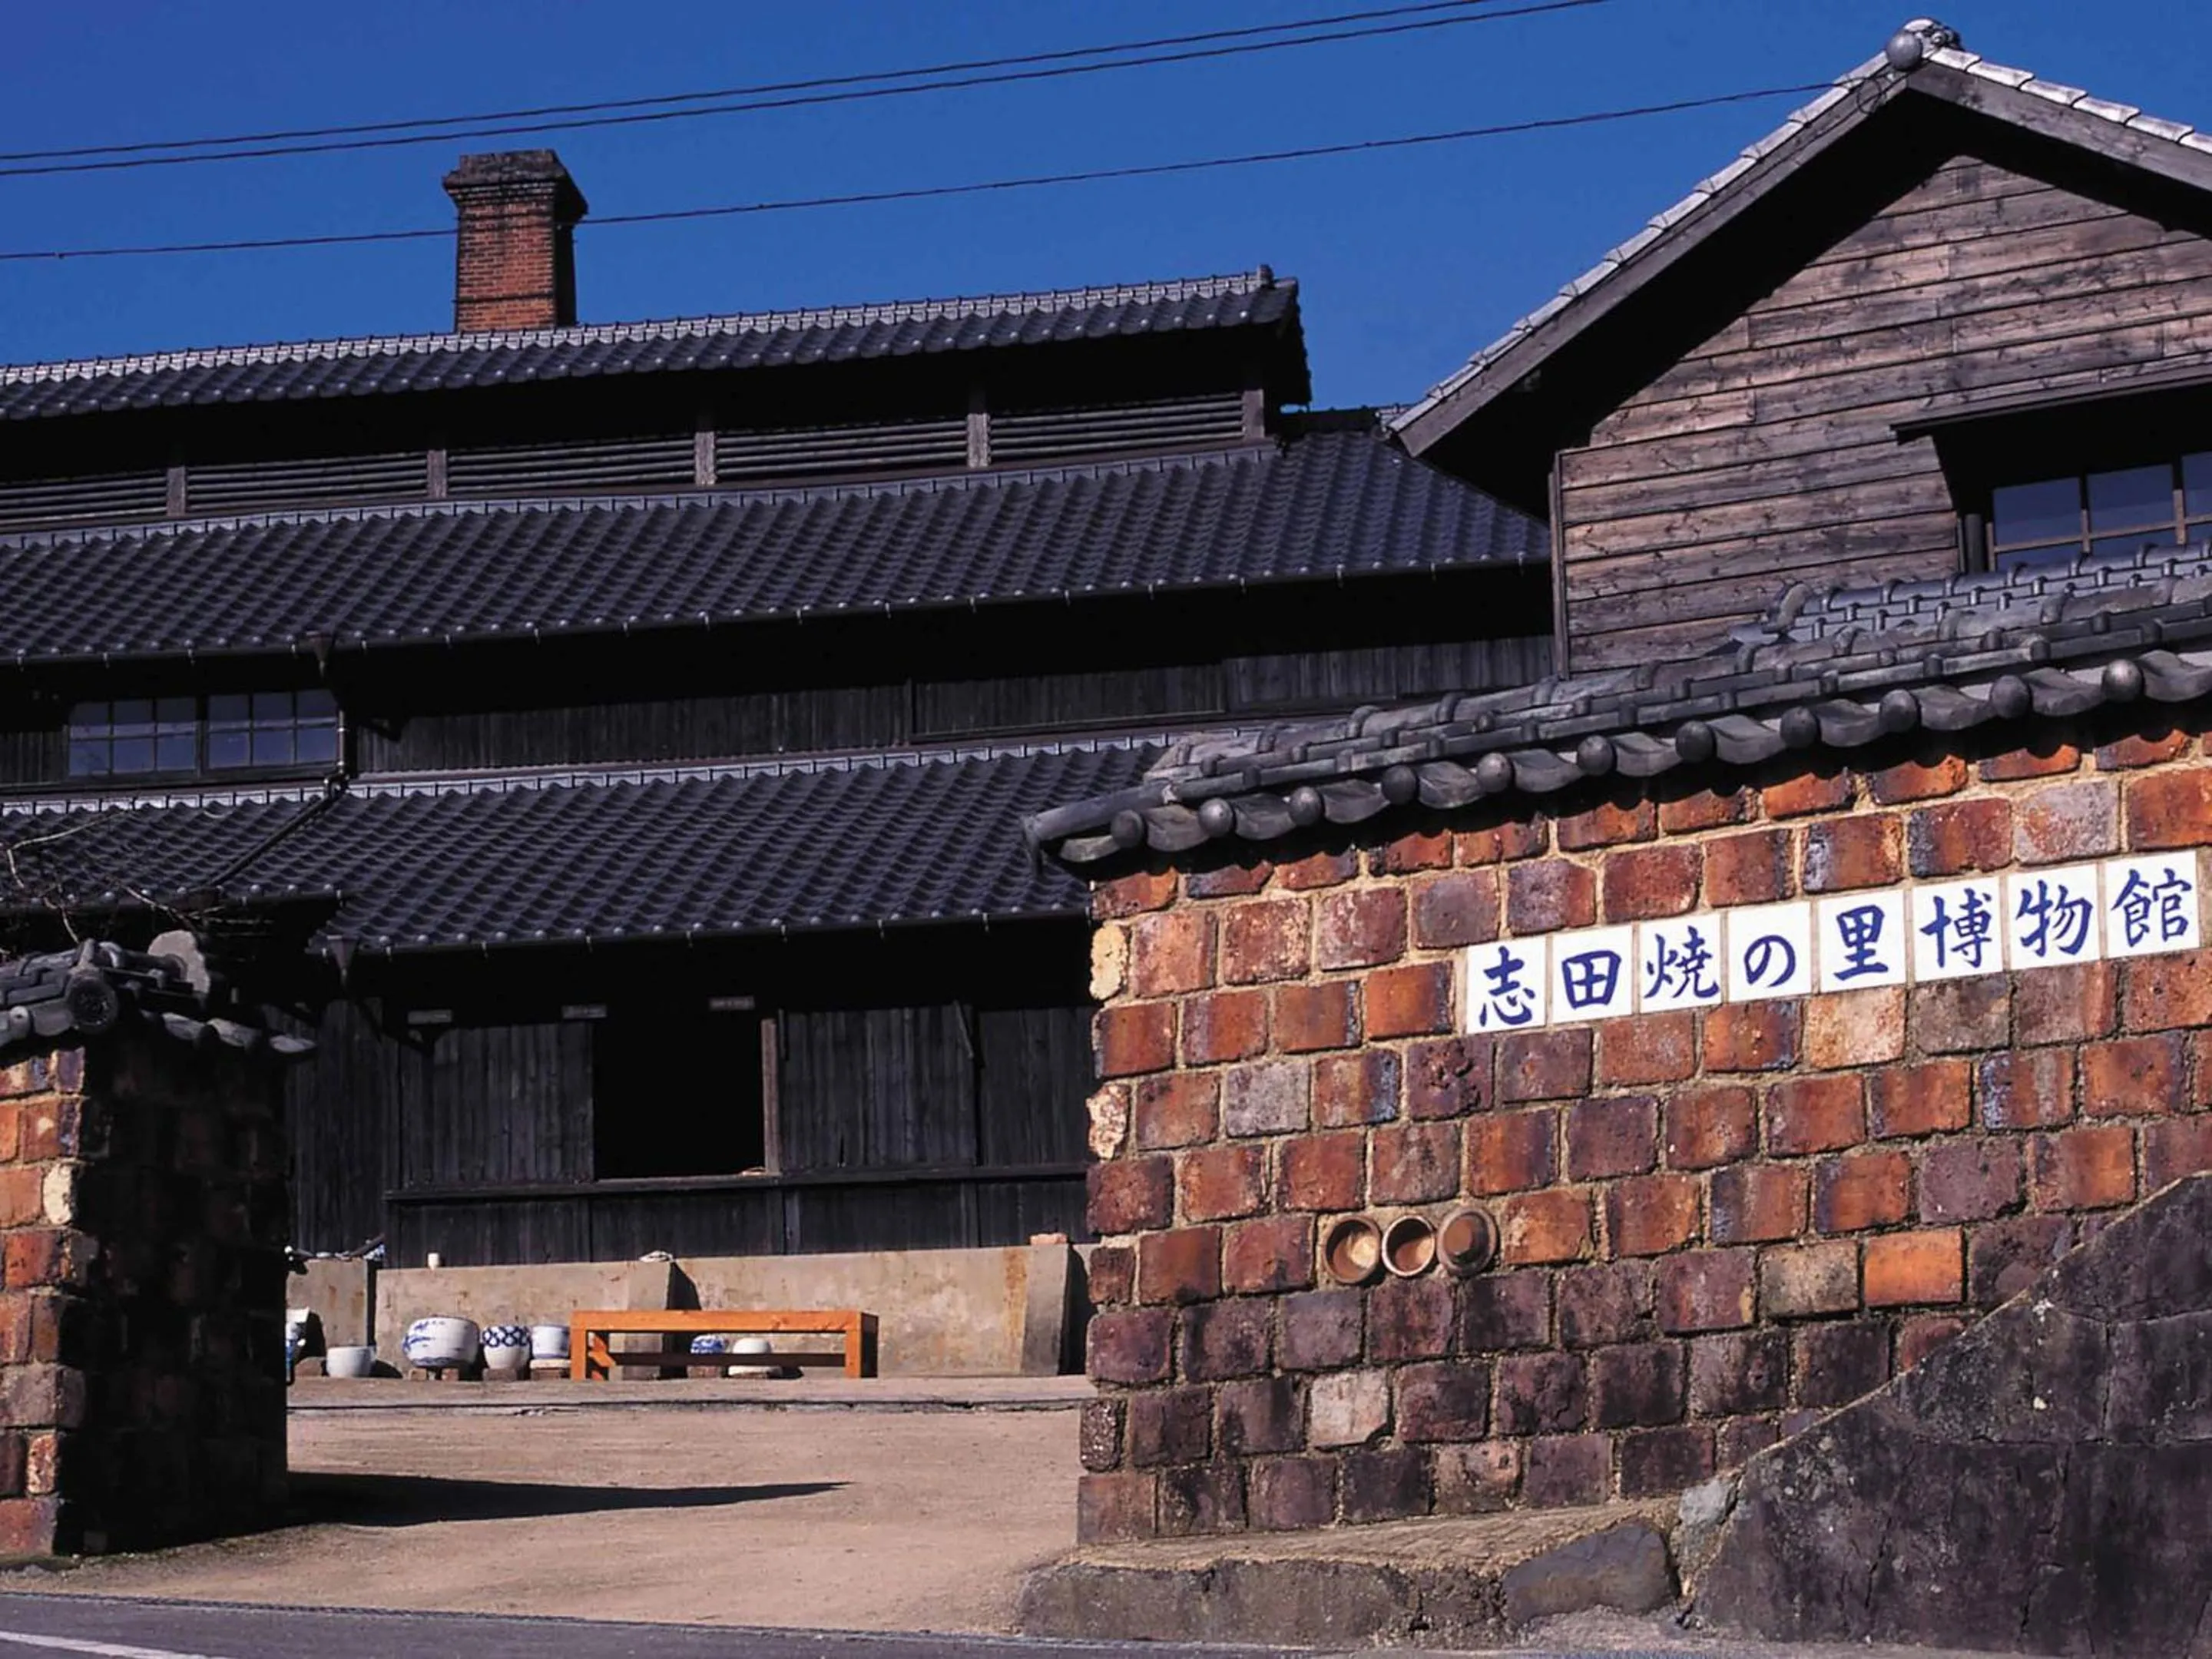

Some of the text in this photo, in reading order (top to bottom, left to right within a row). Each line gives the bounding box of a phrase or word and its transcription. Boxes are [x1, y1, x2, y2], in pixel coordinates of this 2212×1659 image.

[1478, 867, 2194, 1027] 志田焼の里博物館
